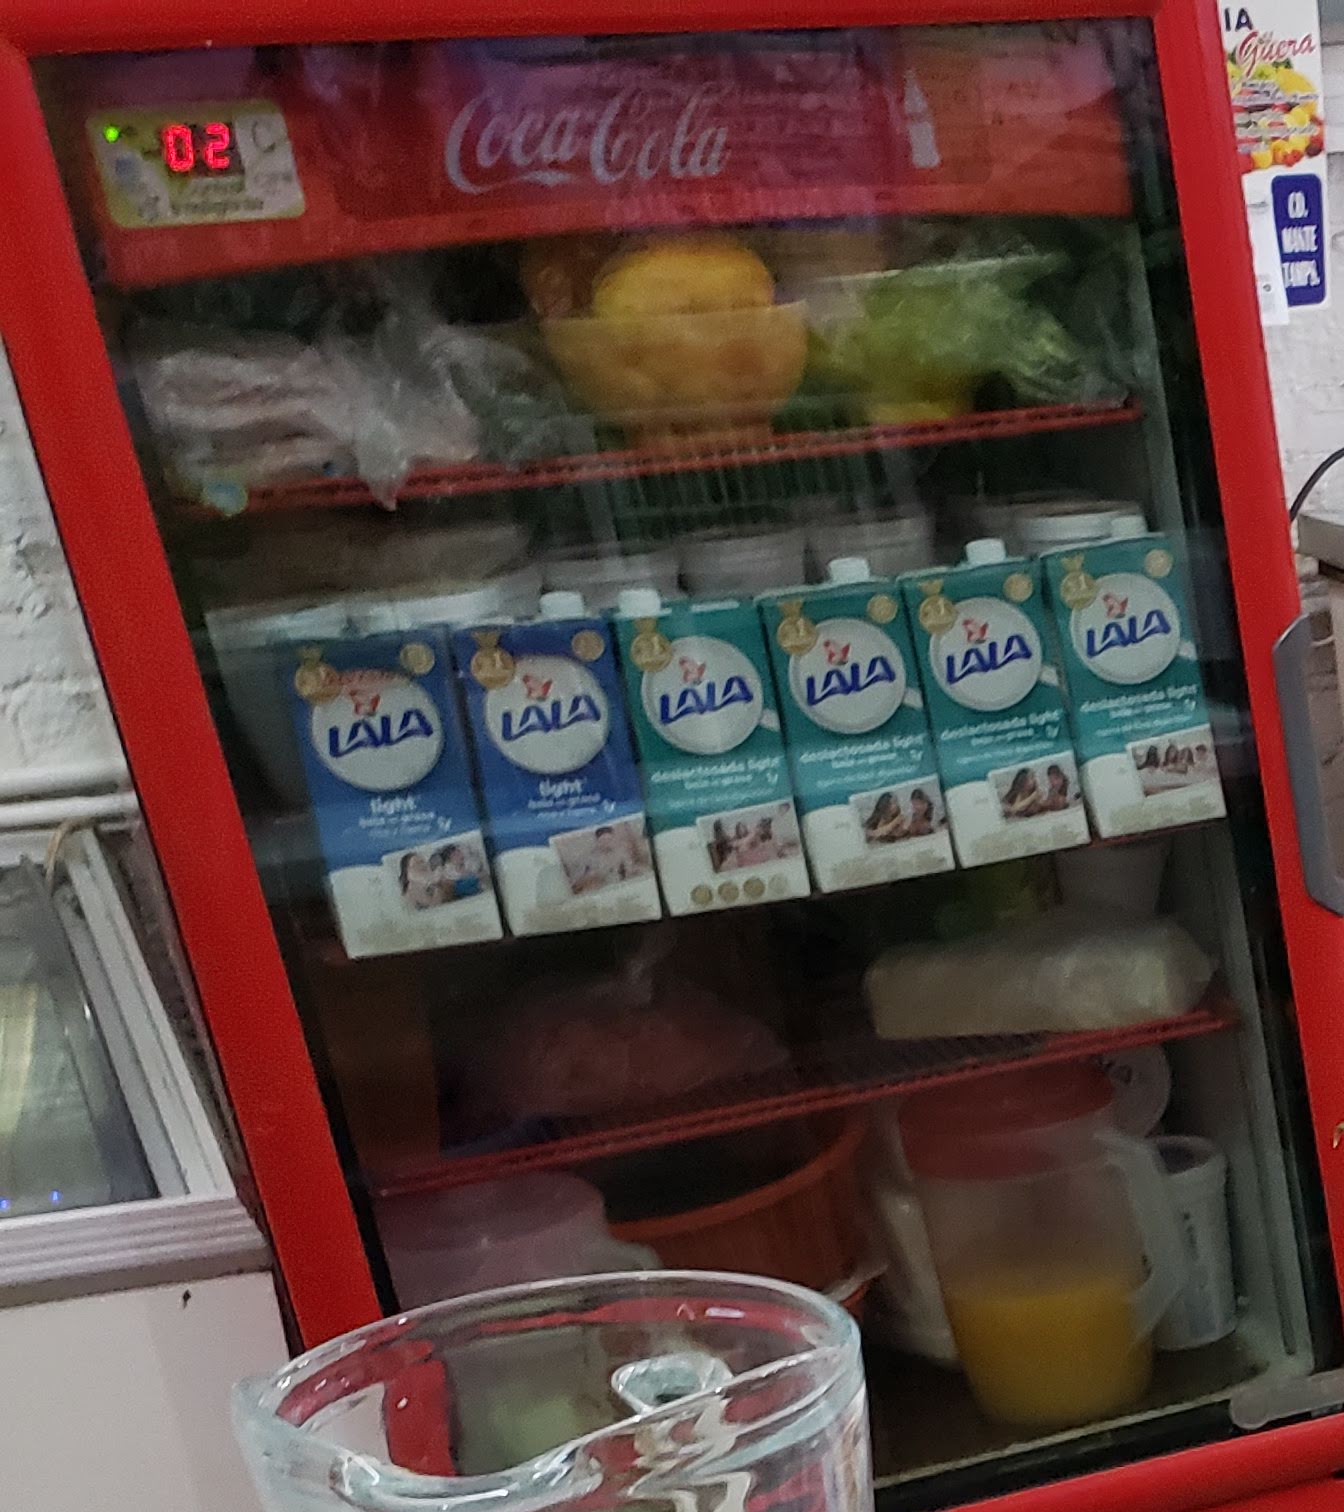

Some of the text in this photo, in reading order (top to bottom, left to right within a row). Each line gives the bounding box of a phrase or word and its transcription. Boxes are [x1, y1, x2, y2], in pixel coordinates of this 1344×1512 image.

[163, 121, 232, 173] 02
[1086, 609, 1172, 659] LALA
[806, 656, 896, 706] LALA
[946, 634, 1033, 686] LALA
[501, 694, 602, 742] LALA
[660, 676, 754, 726] LALA
[328, 709, 434, 759] LALA
